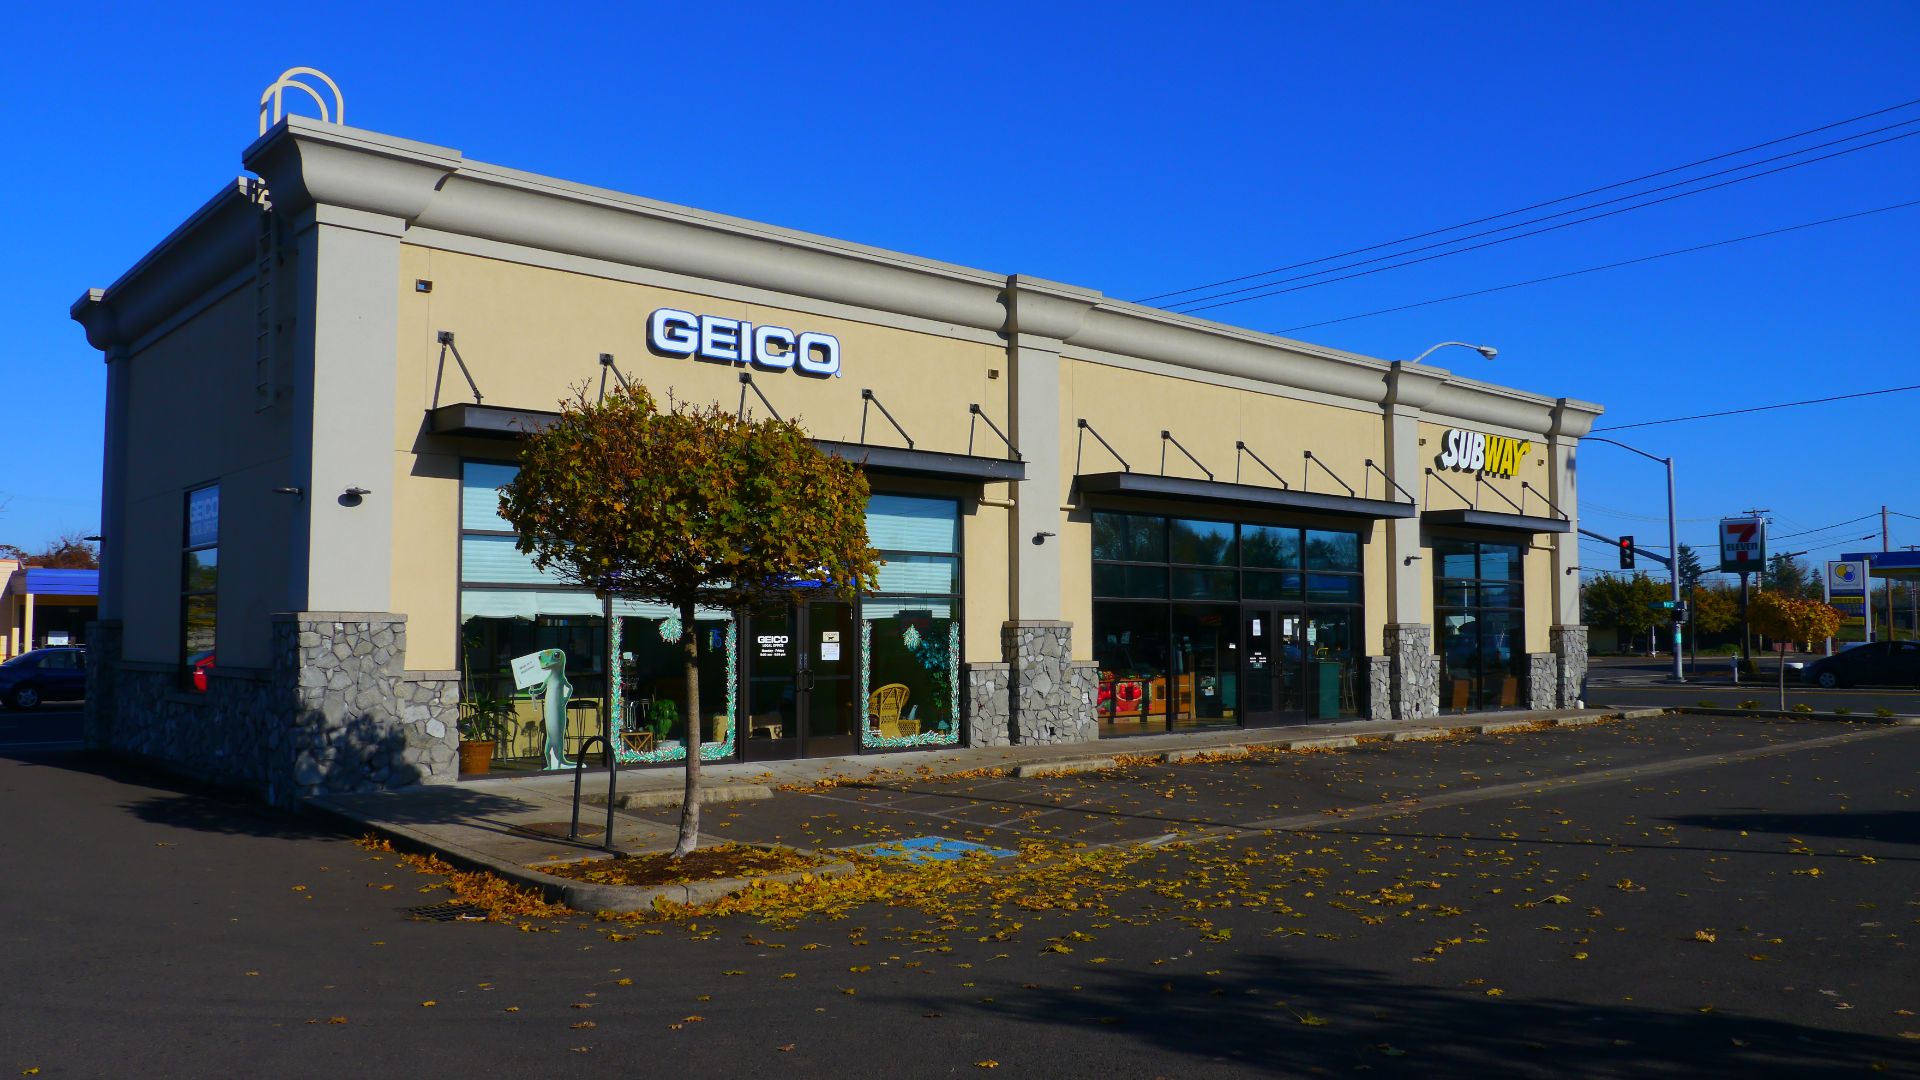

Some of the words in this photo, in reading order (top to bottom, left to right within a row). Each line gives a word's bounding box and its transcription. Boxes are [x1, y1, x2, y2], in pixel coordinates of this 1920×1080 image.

[647, 307, 841, 379] GEICO
[1436, 428, 1531, 478] SUBWAY
[757, 635, 789, 644] GEICO
